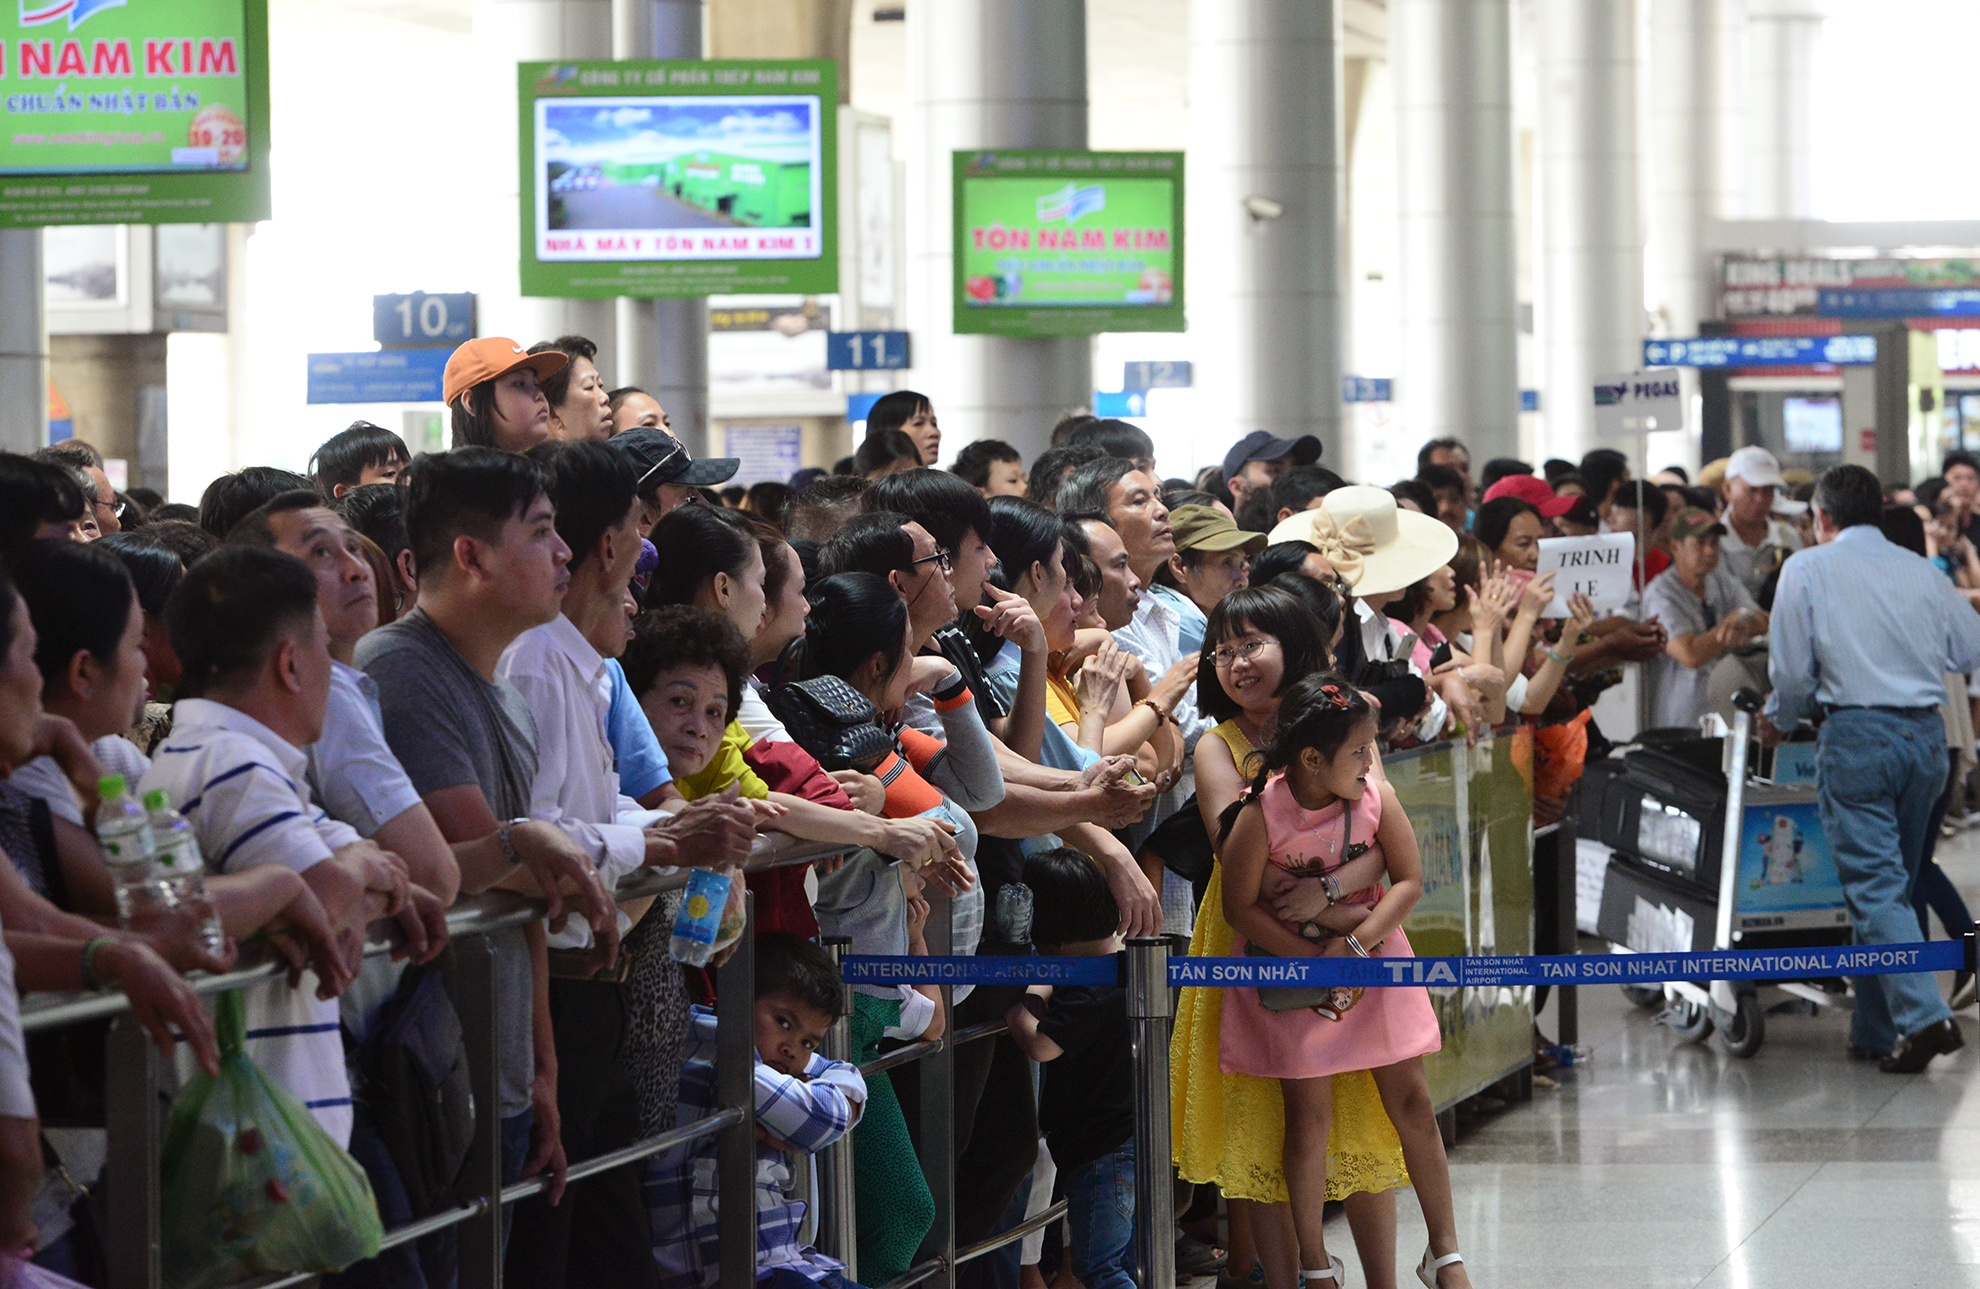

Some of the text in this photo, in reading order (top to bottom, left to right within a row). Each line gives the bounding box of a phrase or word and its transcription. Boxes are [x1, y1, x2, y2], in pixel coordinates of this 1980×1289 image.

[20, 41, 132, 77] NAM
[147, 40, 237, 76] KIM
[546, 235, 585, 251] NHÀ
[597, 235, 642, 251] MÁY
[704, 237, 750, 250] NAM
[757, 237, 794, 250] KIM
[973, 221, 1170, 251] TÔN NAM KIM
[395, 296, 448, 338] 10
[848, 334, 886, 367] 11
[1137, 361, 1175, 388] 12
[1634, 381, 1679, 398] PEGAS
[1559, 548, 1619, 567] TRINH
[1169, 962, 1309, 981] TÂN SƠN NHẤT
[1383, 961, 1457, 982] TIA
[1465, 957, 1525, 966] TAN SON NHAT
[1465, 967, 1530, 976] INTERNATIONAL
[1541, 950, 1920, 978] TAN SON NHAT INTERNATIONAL AIRPORT
[1466, 976, 1502, 985] AIRPORT
